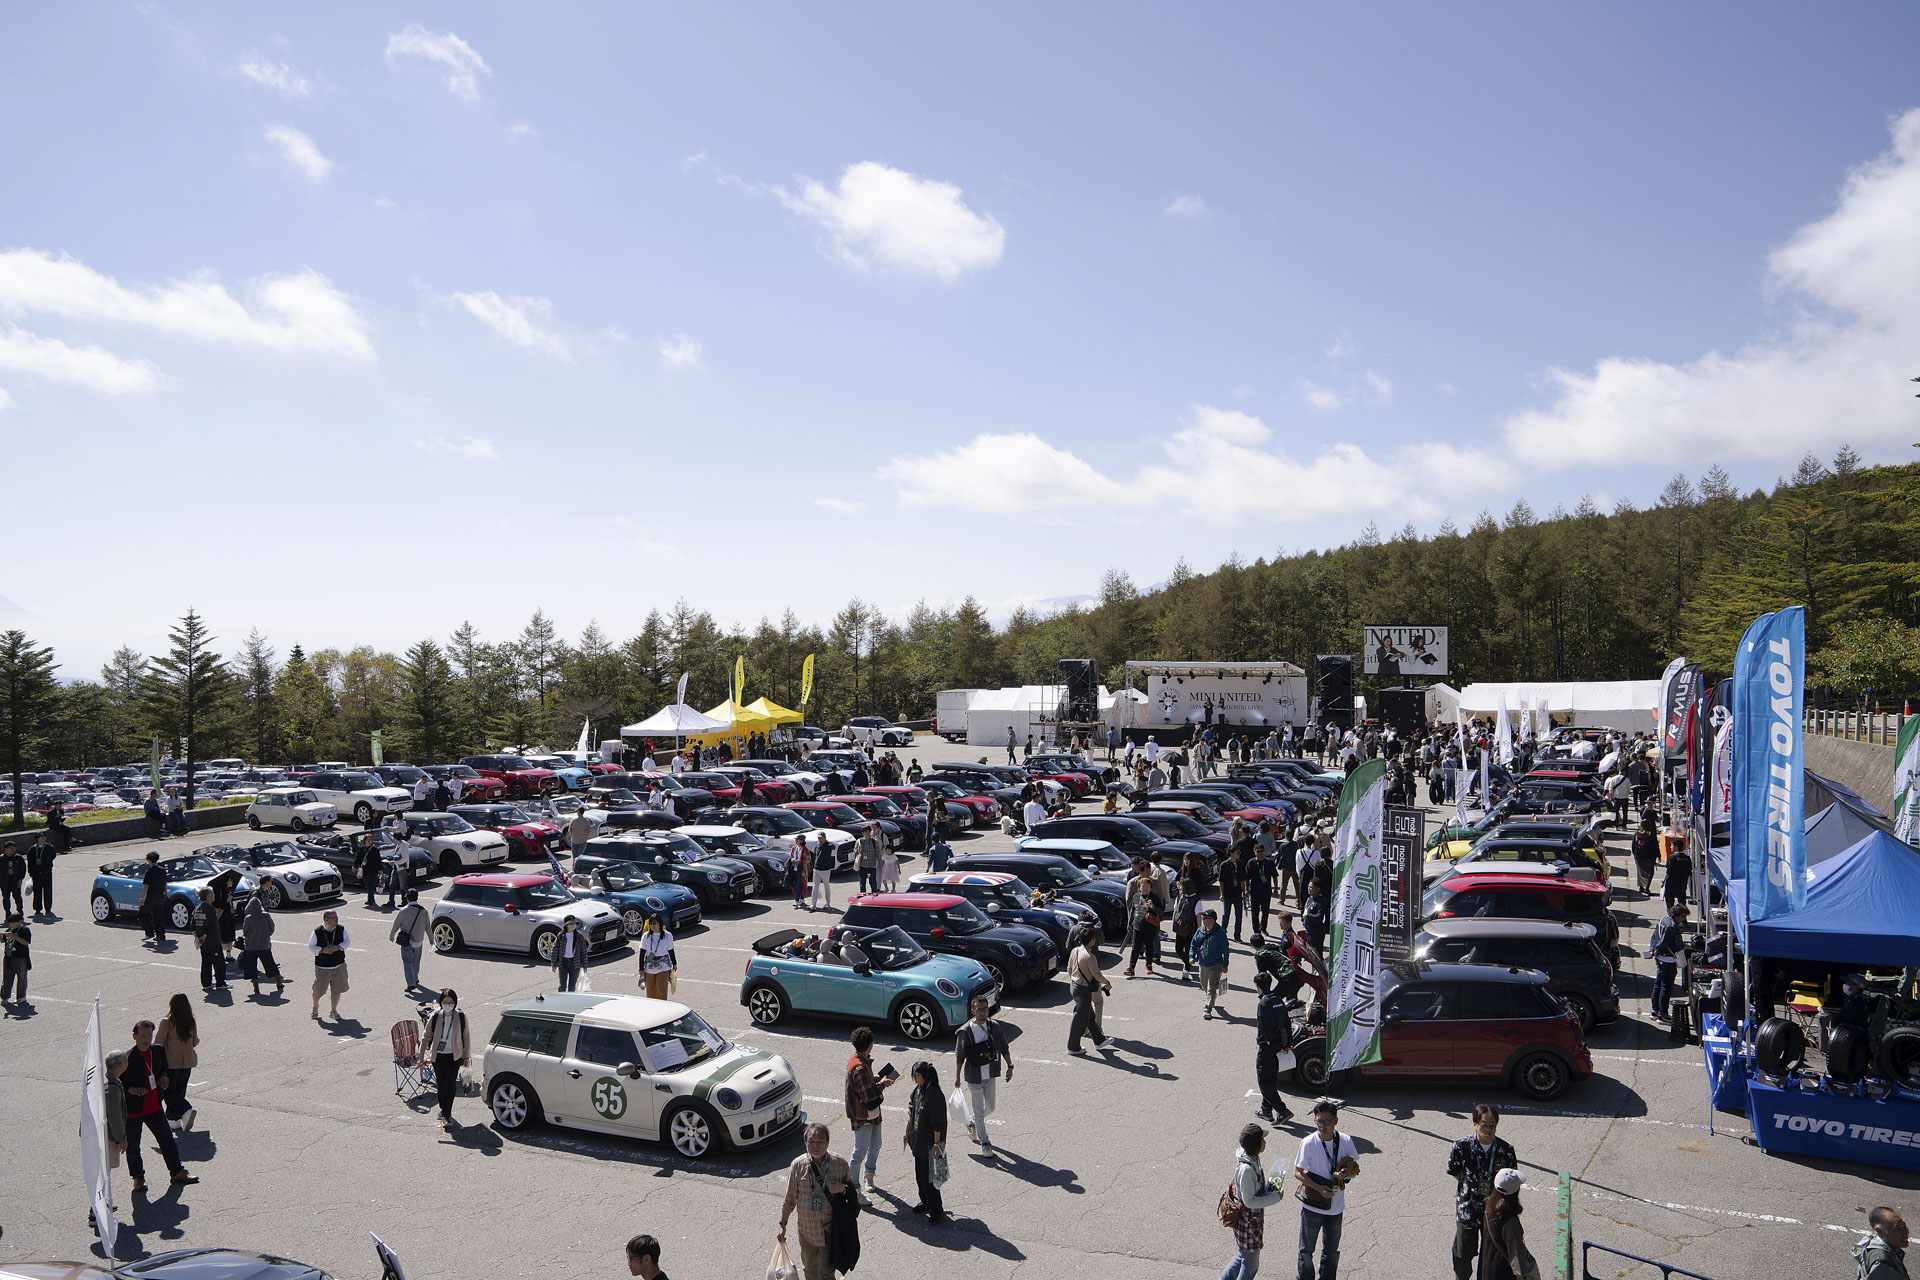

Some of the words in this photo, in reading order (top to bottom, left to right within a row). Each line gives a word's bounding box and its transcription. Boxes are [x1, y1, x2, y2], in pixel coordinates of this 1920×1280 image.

[1189, 691, 1215, 702] MINI
[1218, 691, 1264, 702] UNITED.
[1668, 670, 1693, 739] REMUS
[1769, 636, 1793, 757] TOYO
[1766, 759, 1793, 895] TIRES
[1344, 903, 1352, 926] Your
[1340, 926, 1352, 967] Driving
[1340, 969, 1349, 1009] Pleasure
[1352, 911, 1375, 1029] TEIN
[594, 1081, 623, 1113] 55
[1773, 1113, 1846, 1137] TOYO
